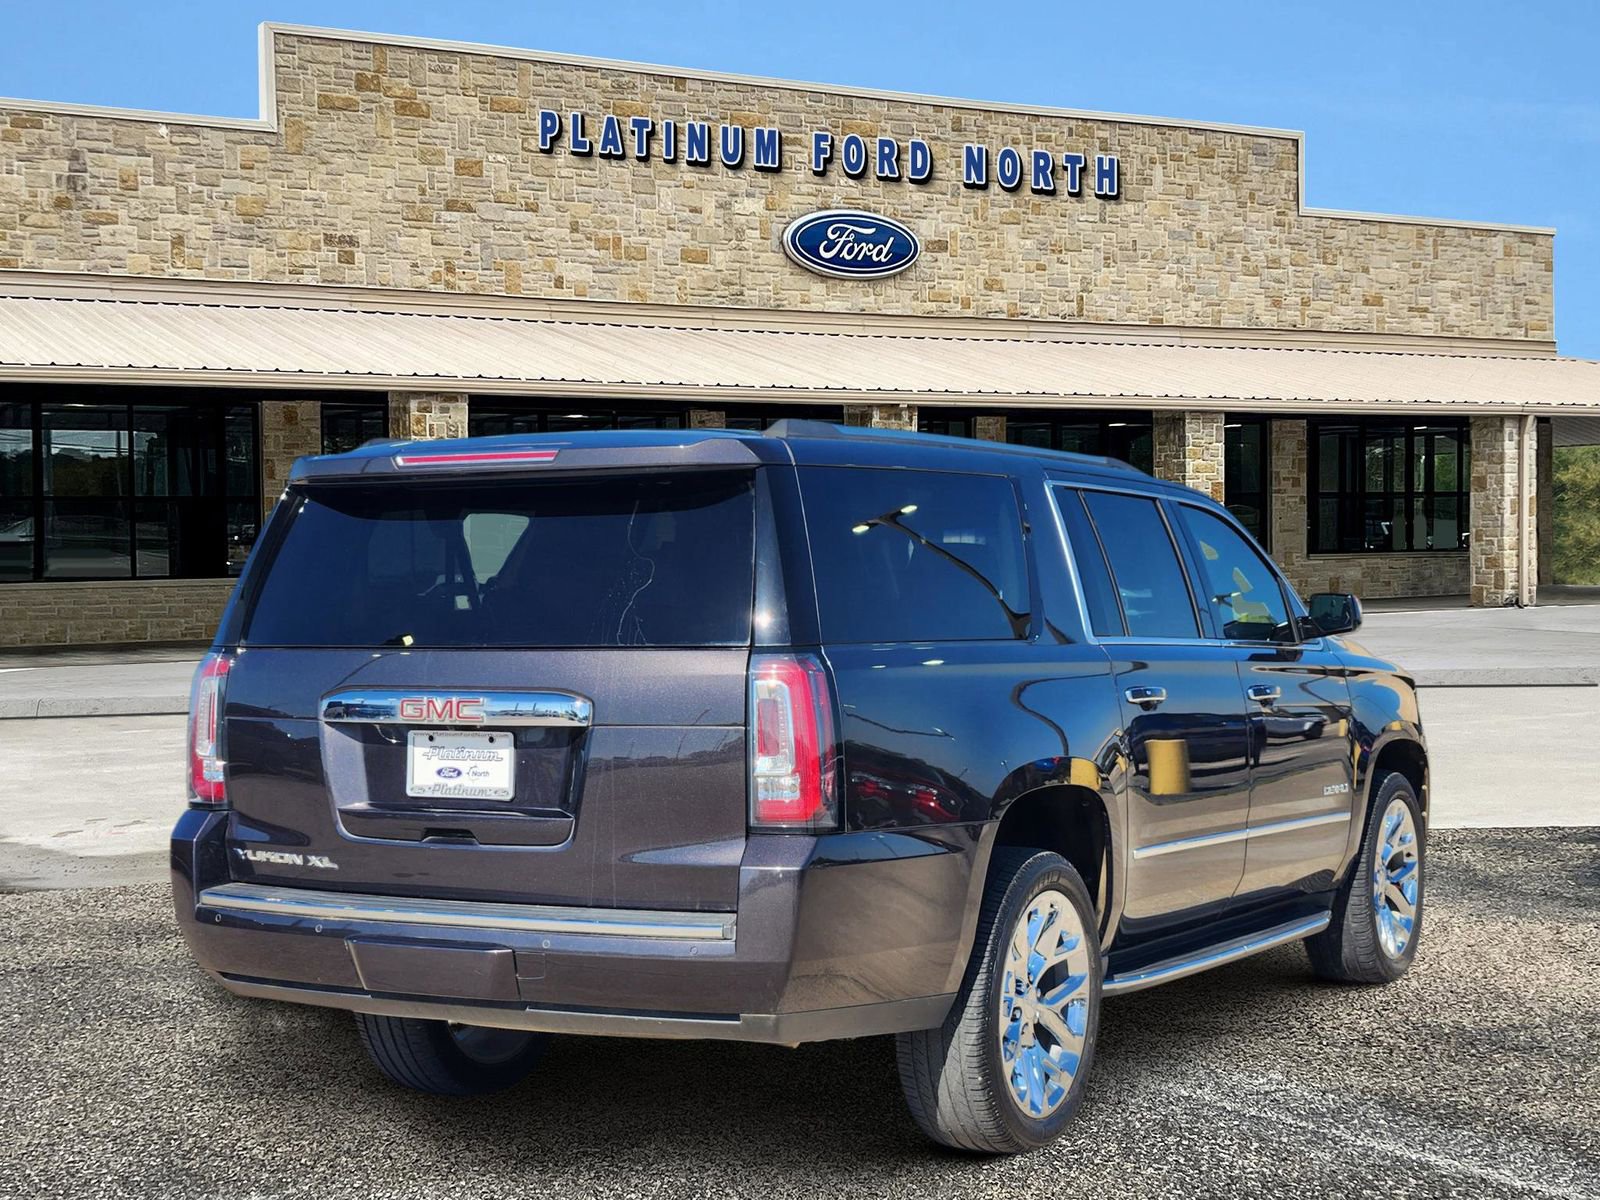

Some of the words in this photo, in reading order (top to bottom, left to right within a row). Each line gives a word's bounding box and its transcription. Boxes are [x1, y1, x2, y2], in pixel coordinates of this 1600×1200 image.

[539, 109, 782, 172] PLATINUM
[812, 131, 933, 184] FORD
[964, 143, 1121, 199] NORTH
[818, 222, 895, 264] Ford
[400, 697, 486, 723] GMC
[422, 745, 504, 761] Platinum
[471, 769, 490, 778] North
[431, 783, 490, 797] Platinum
[233, 847, 304, 866] YUKON
[306, 854, 339, 870] XL
